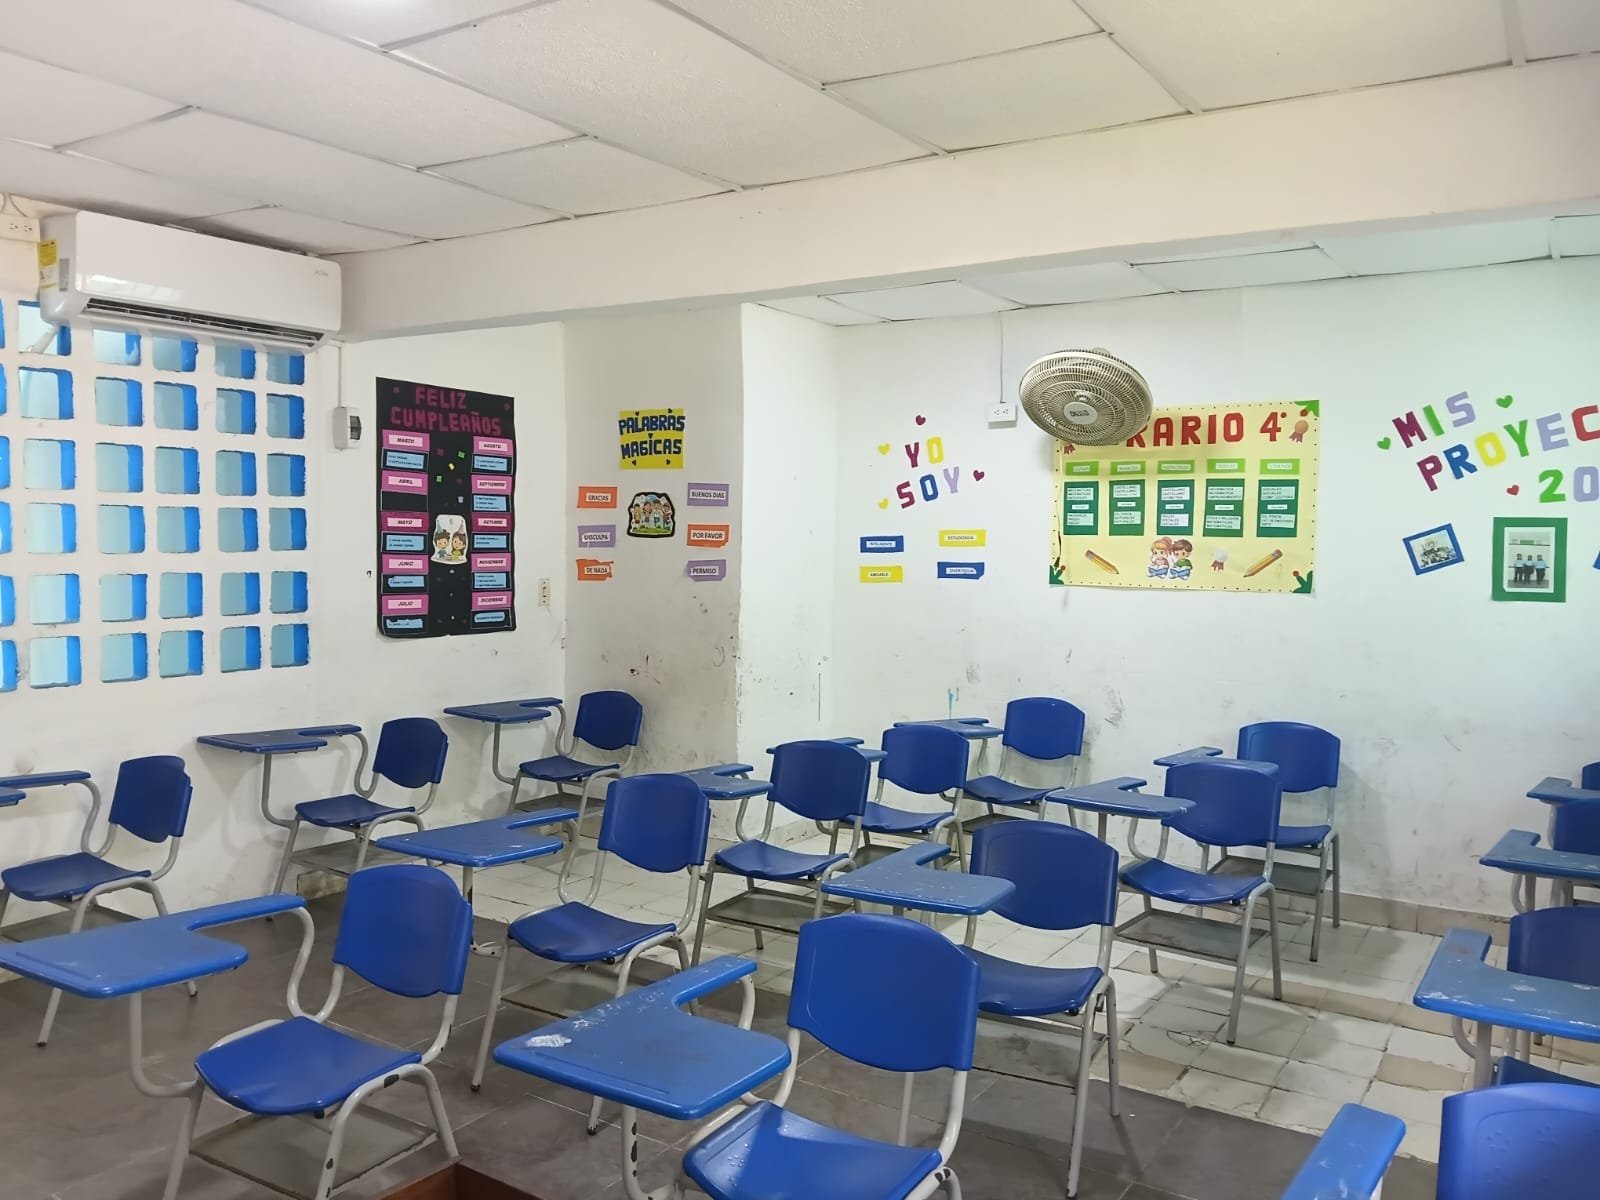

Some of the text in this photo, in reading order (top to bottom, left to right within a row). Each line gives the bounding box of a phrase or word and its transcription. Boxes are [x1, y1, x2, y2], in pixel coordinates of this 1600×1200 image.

[415, 386, 467, 409] FELIZ
[390, 406, 502, 436] CUMPLEAÑOS
[618, 415, 686, 436] PALABRAS
[1391, 391, 1477, 449] MIS
[904, 436, 945, 468] YO
[896, 466, 960, 509] SOY
